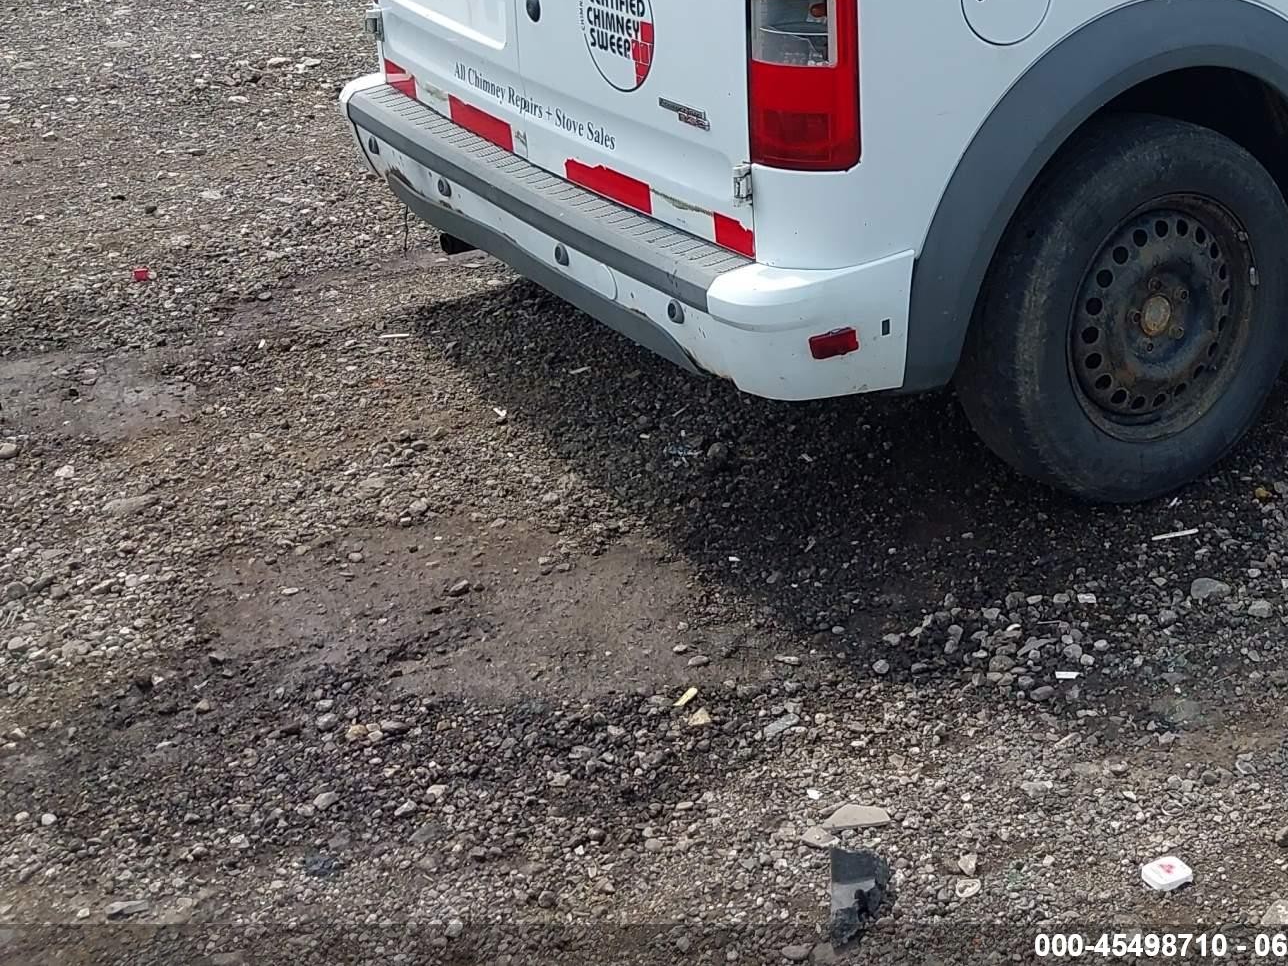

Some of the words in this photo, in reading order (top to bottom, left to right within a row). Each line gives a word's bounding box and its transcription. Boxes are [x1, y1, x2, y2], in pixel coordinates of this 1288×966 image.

[587, 6, 640, 40] CHIMNEY
[454, 62, 466, 82] All
[467, 67, 506, 104] Chimney
[508, 86, 543, 119] Repairs
[555, 107, 584, 137] Stove
[587, 122, 616, 151] Sales
